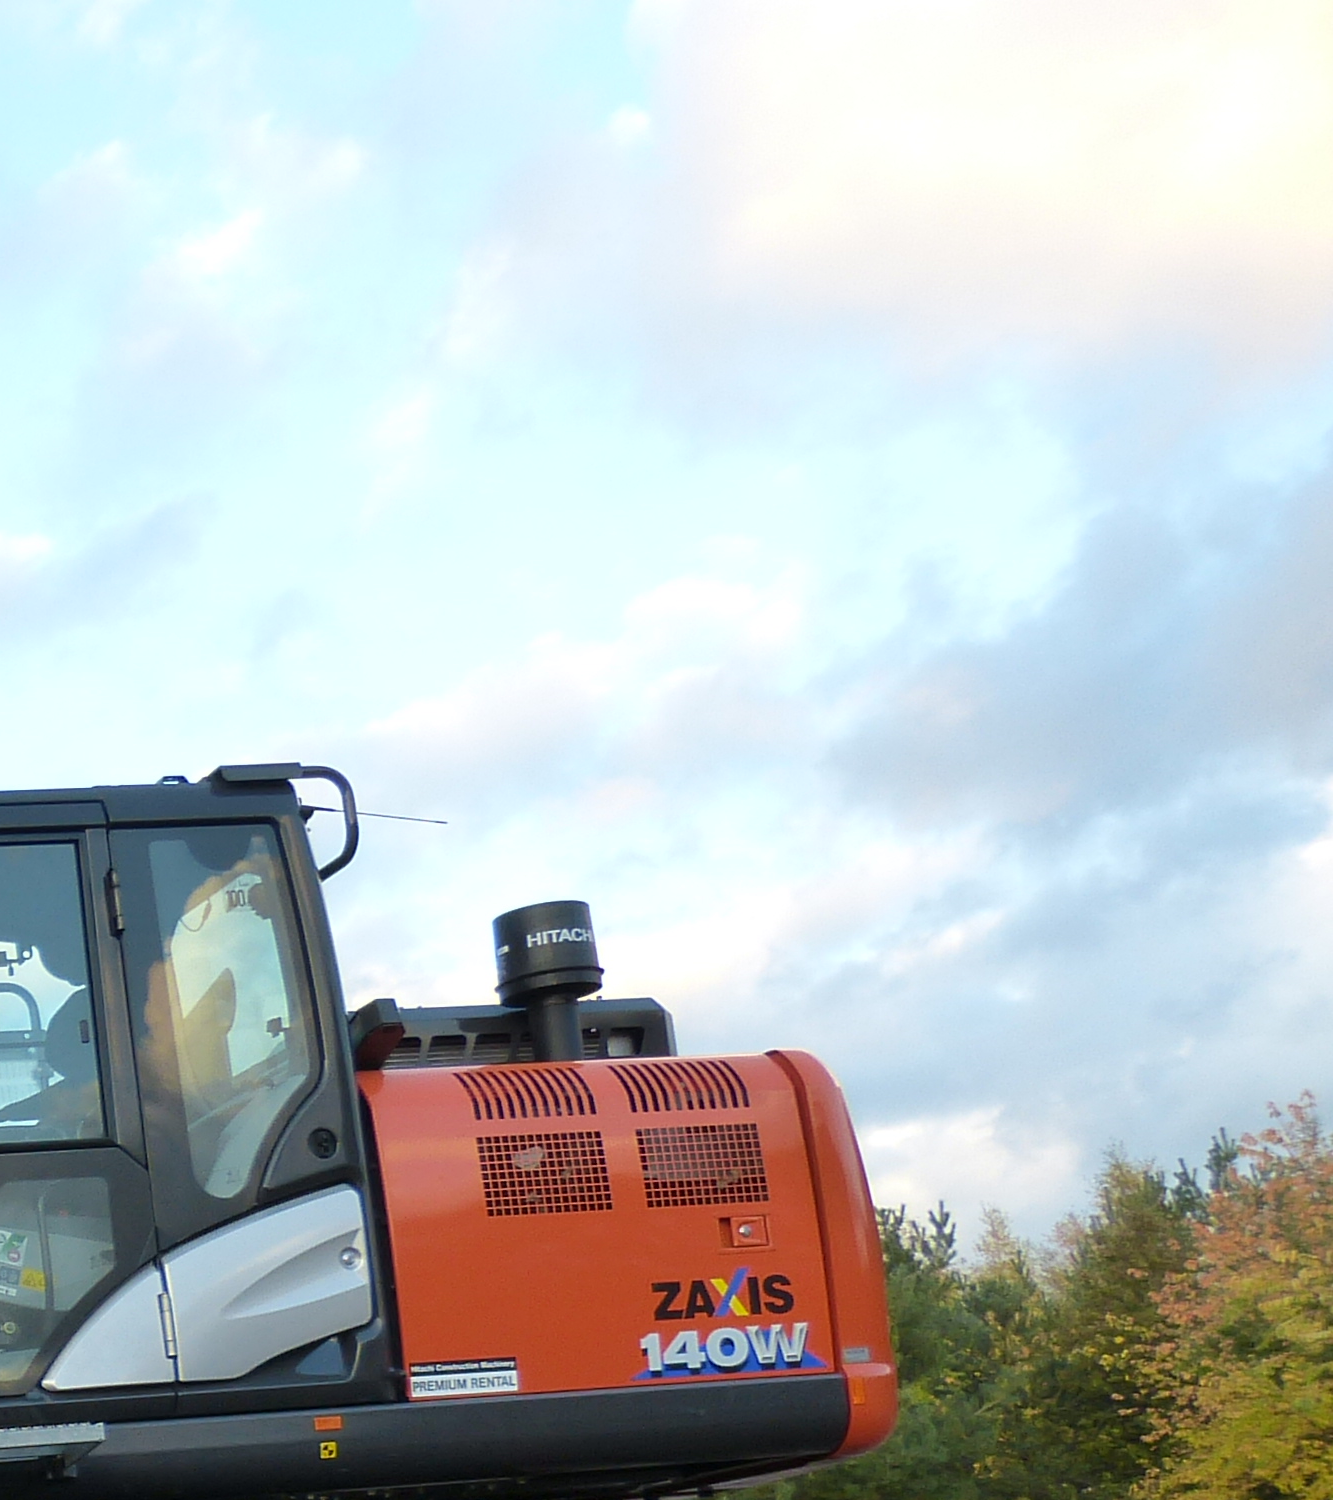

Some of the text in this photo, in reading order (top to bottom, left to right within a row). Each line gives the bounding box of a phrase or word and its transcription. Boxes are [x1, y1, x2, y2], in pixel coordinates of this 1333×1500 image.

[526, 928, 593, 948] HITACH
[651, 1266, 795, 1321] ZAXIS
[640, 1322, 808, 1374] 140W
[412, 1375, 516, 1393] PREMIUM RENTAL
